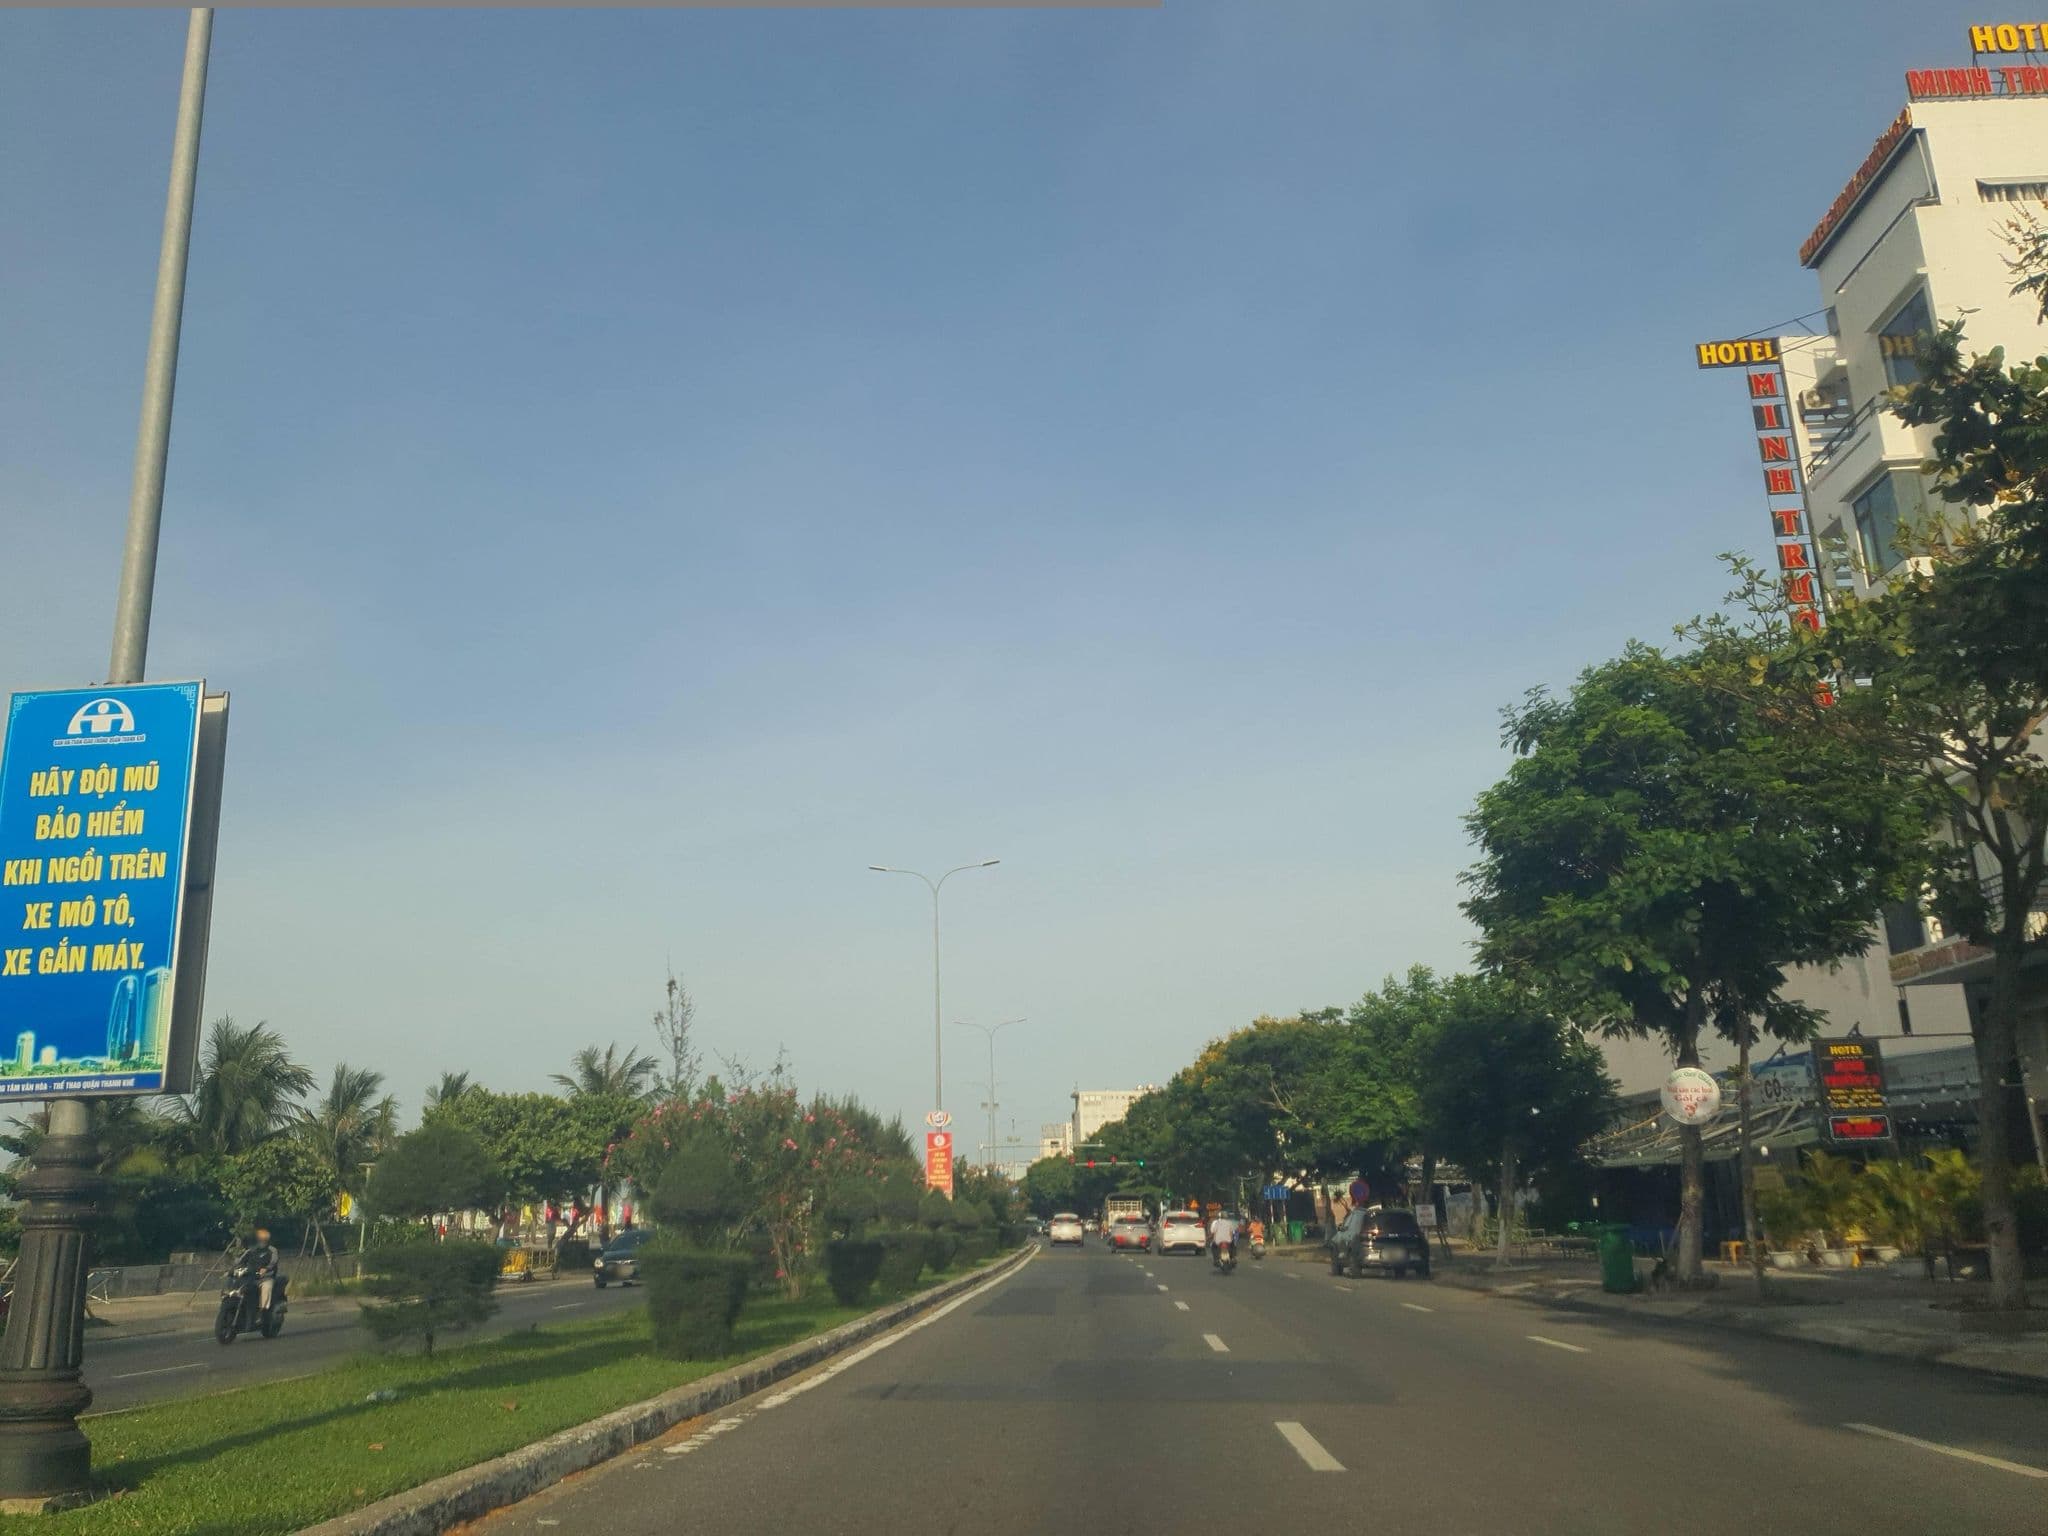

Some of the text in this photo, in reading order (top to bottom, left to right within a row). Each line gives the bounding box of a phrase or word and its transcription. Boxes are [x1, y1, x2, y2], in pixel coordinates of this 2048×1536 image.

[1906, 67, 1994, 97] MINH
[1700, 341, 1778, 365] HOTEL
[1750, 372, 1797, 494] MINH
[30, 761, 159, 799] HÃY ĐỘI MŨ
[35, 800, 145, 840] BẢO HIỂM
[3, 847, 166, 886] KHI NGỒI TRÊN
[22, 893, 135, 929] XE MÔ TÔ,
[2, 937, 144, 976] XE GẮN MÁY.
[1829, 1045, 1863, 1055] HOTEL
